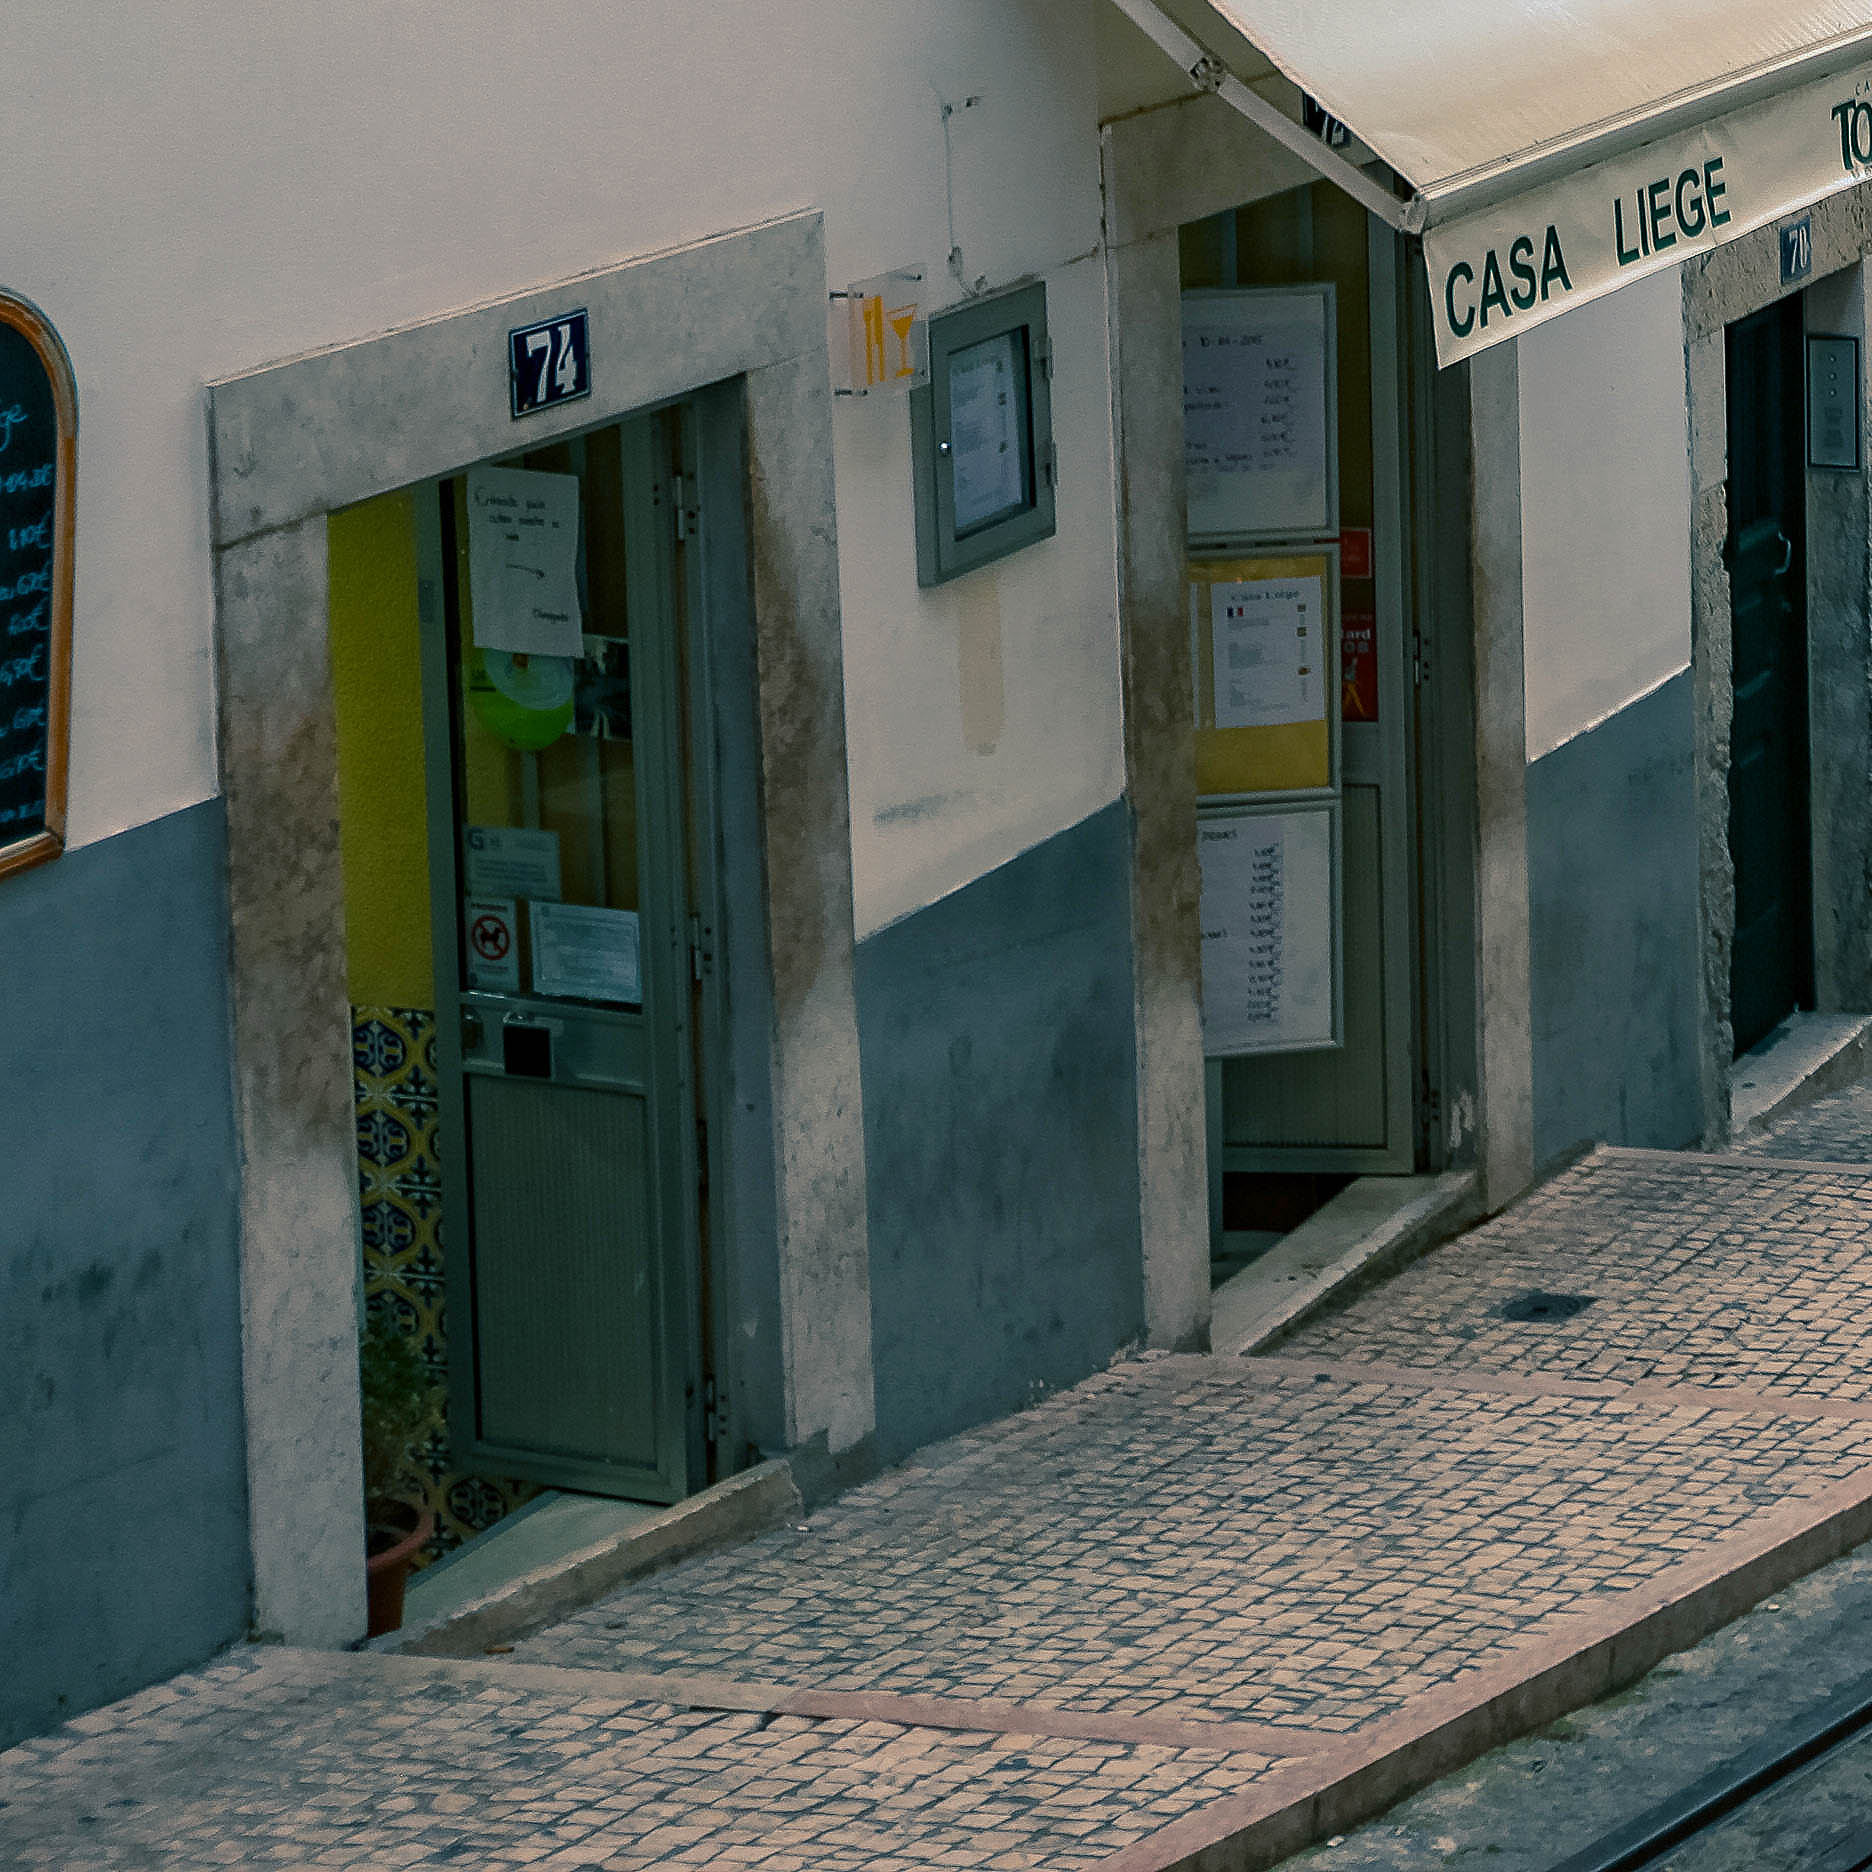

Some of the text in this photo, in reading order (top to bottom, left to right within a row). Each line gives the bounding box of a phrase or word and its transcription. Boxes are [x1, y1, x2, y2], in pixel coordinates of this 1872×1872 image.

[1445, 155, 1732, 339] CASA LIEGE
[1788, 225, 1810, 275] 70
[525, 322, 579, 406] 74
